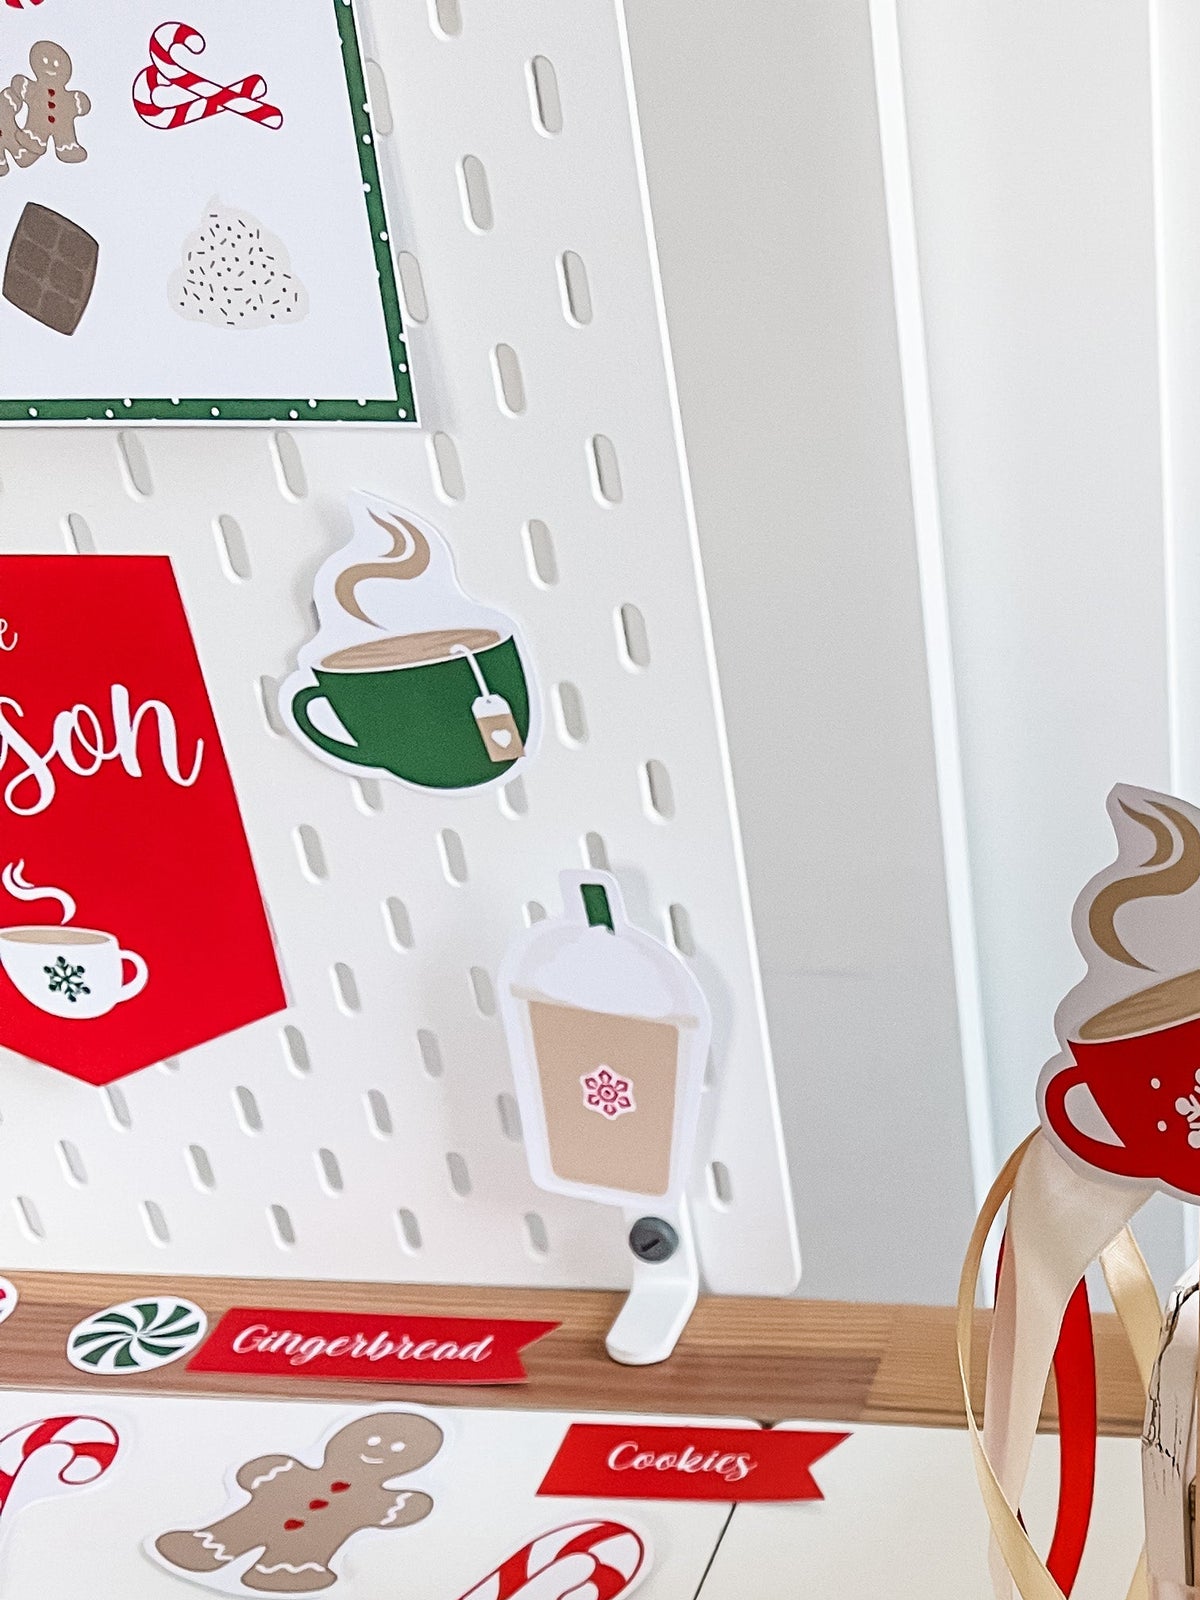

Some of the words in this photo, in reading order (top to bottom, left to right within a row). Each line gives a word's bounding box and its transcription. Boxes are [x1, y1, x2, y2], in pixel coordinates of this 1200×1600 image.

[0, 683, 204, 816] son
[232, 1323, 495, 1366] Gingerbread
[608, 1440, 758, 1482] Cookies
